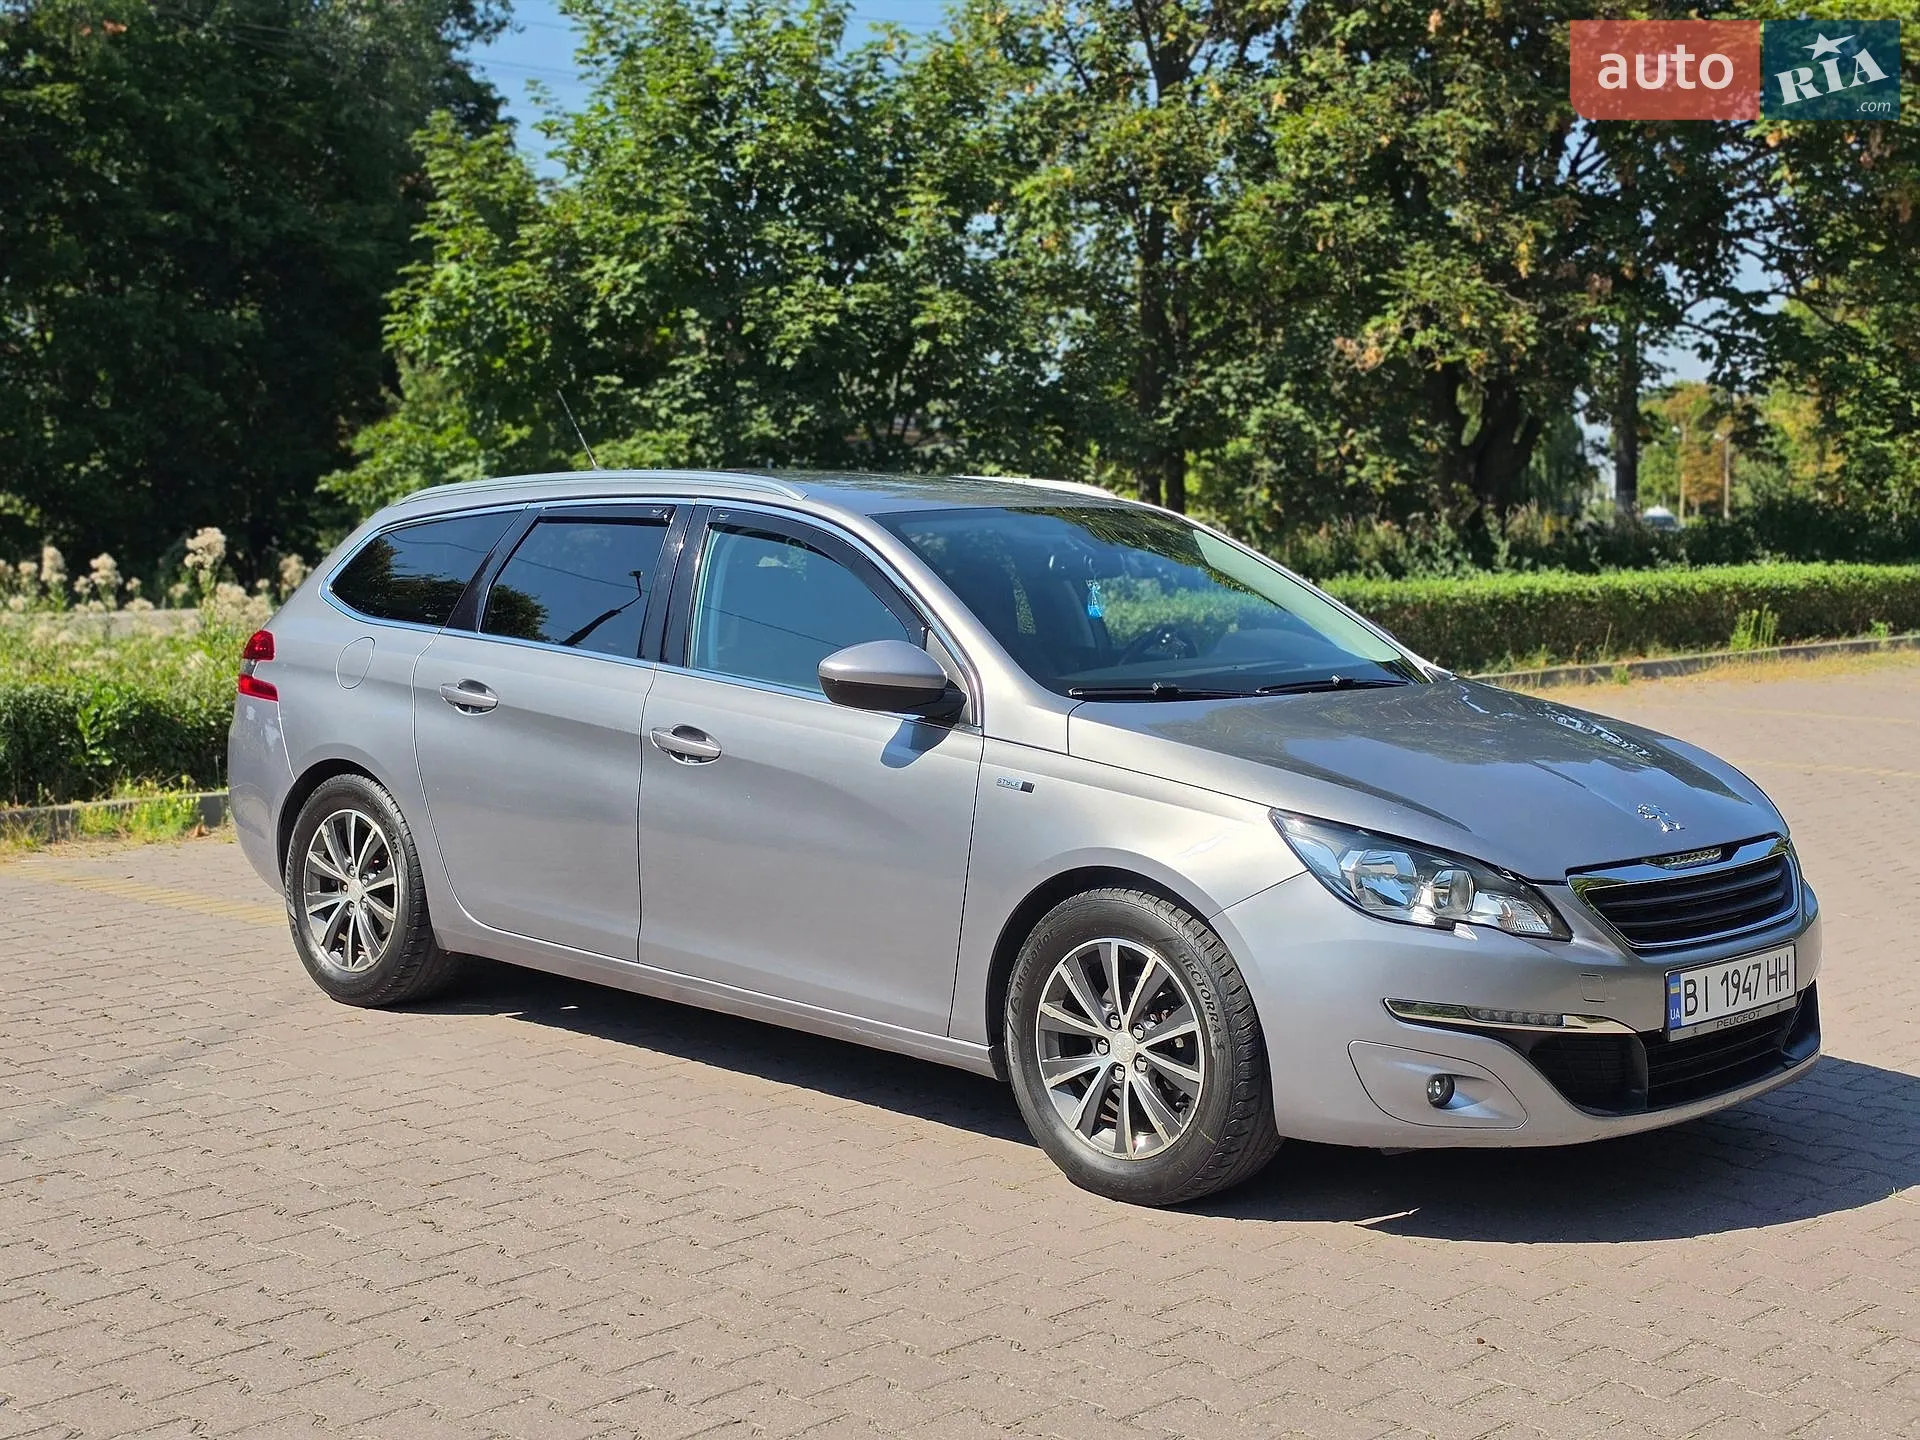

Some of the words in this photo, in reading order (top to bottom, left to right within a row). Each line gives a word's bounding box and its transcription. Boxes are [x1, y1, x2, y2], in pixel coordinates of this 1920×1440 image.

[997, 777, 1020, 788] STYLE
[1179, 952, 1222, 1034] HECTORRA
[1684, 975, 1709, 1017] BI
[1720, 961, 1761, 1008] 1947
[1766, 954, 1789, 996] HH
[1670, 1008, 1681, 1021] UA
[1716, 1010, 1761, 1029] PEUGEOT
